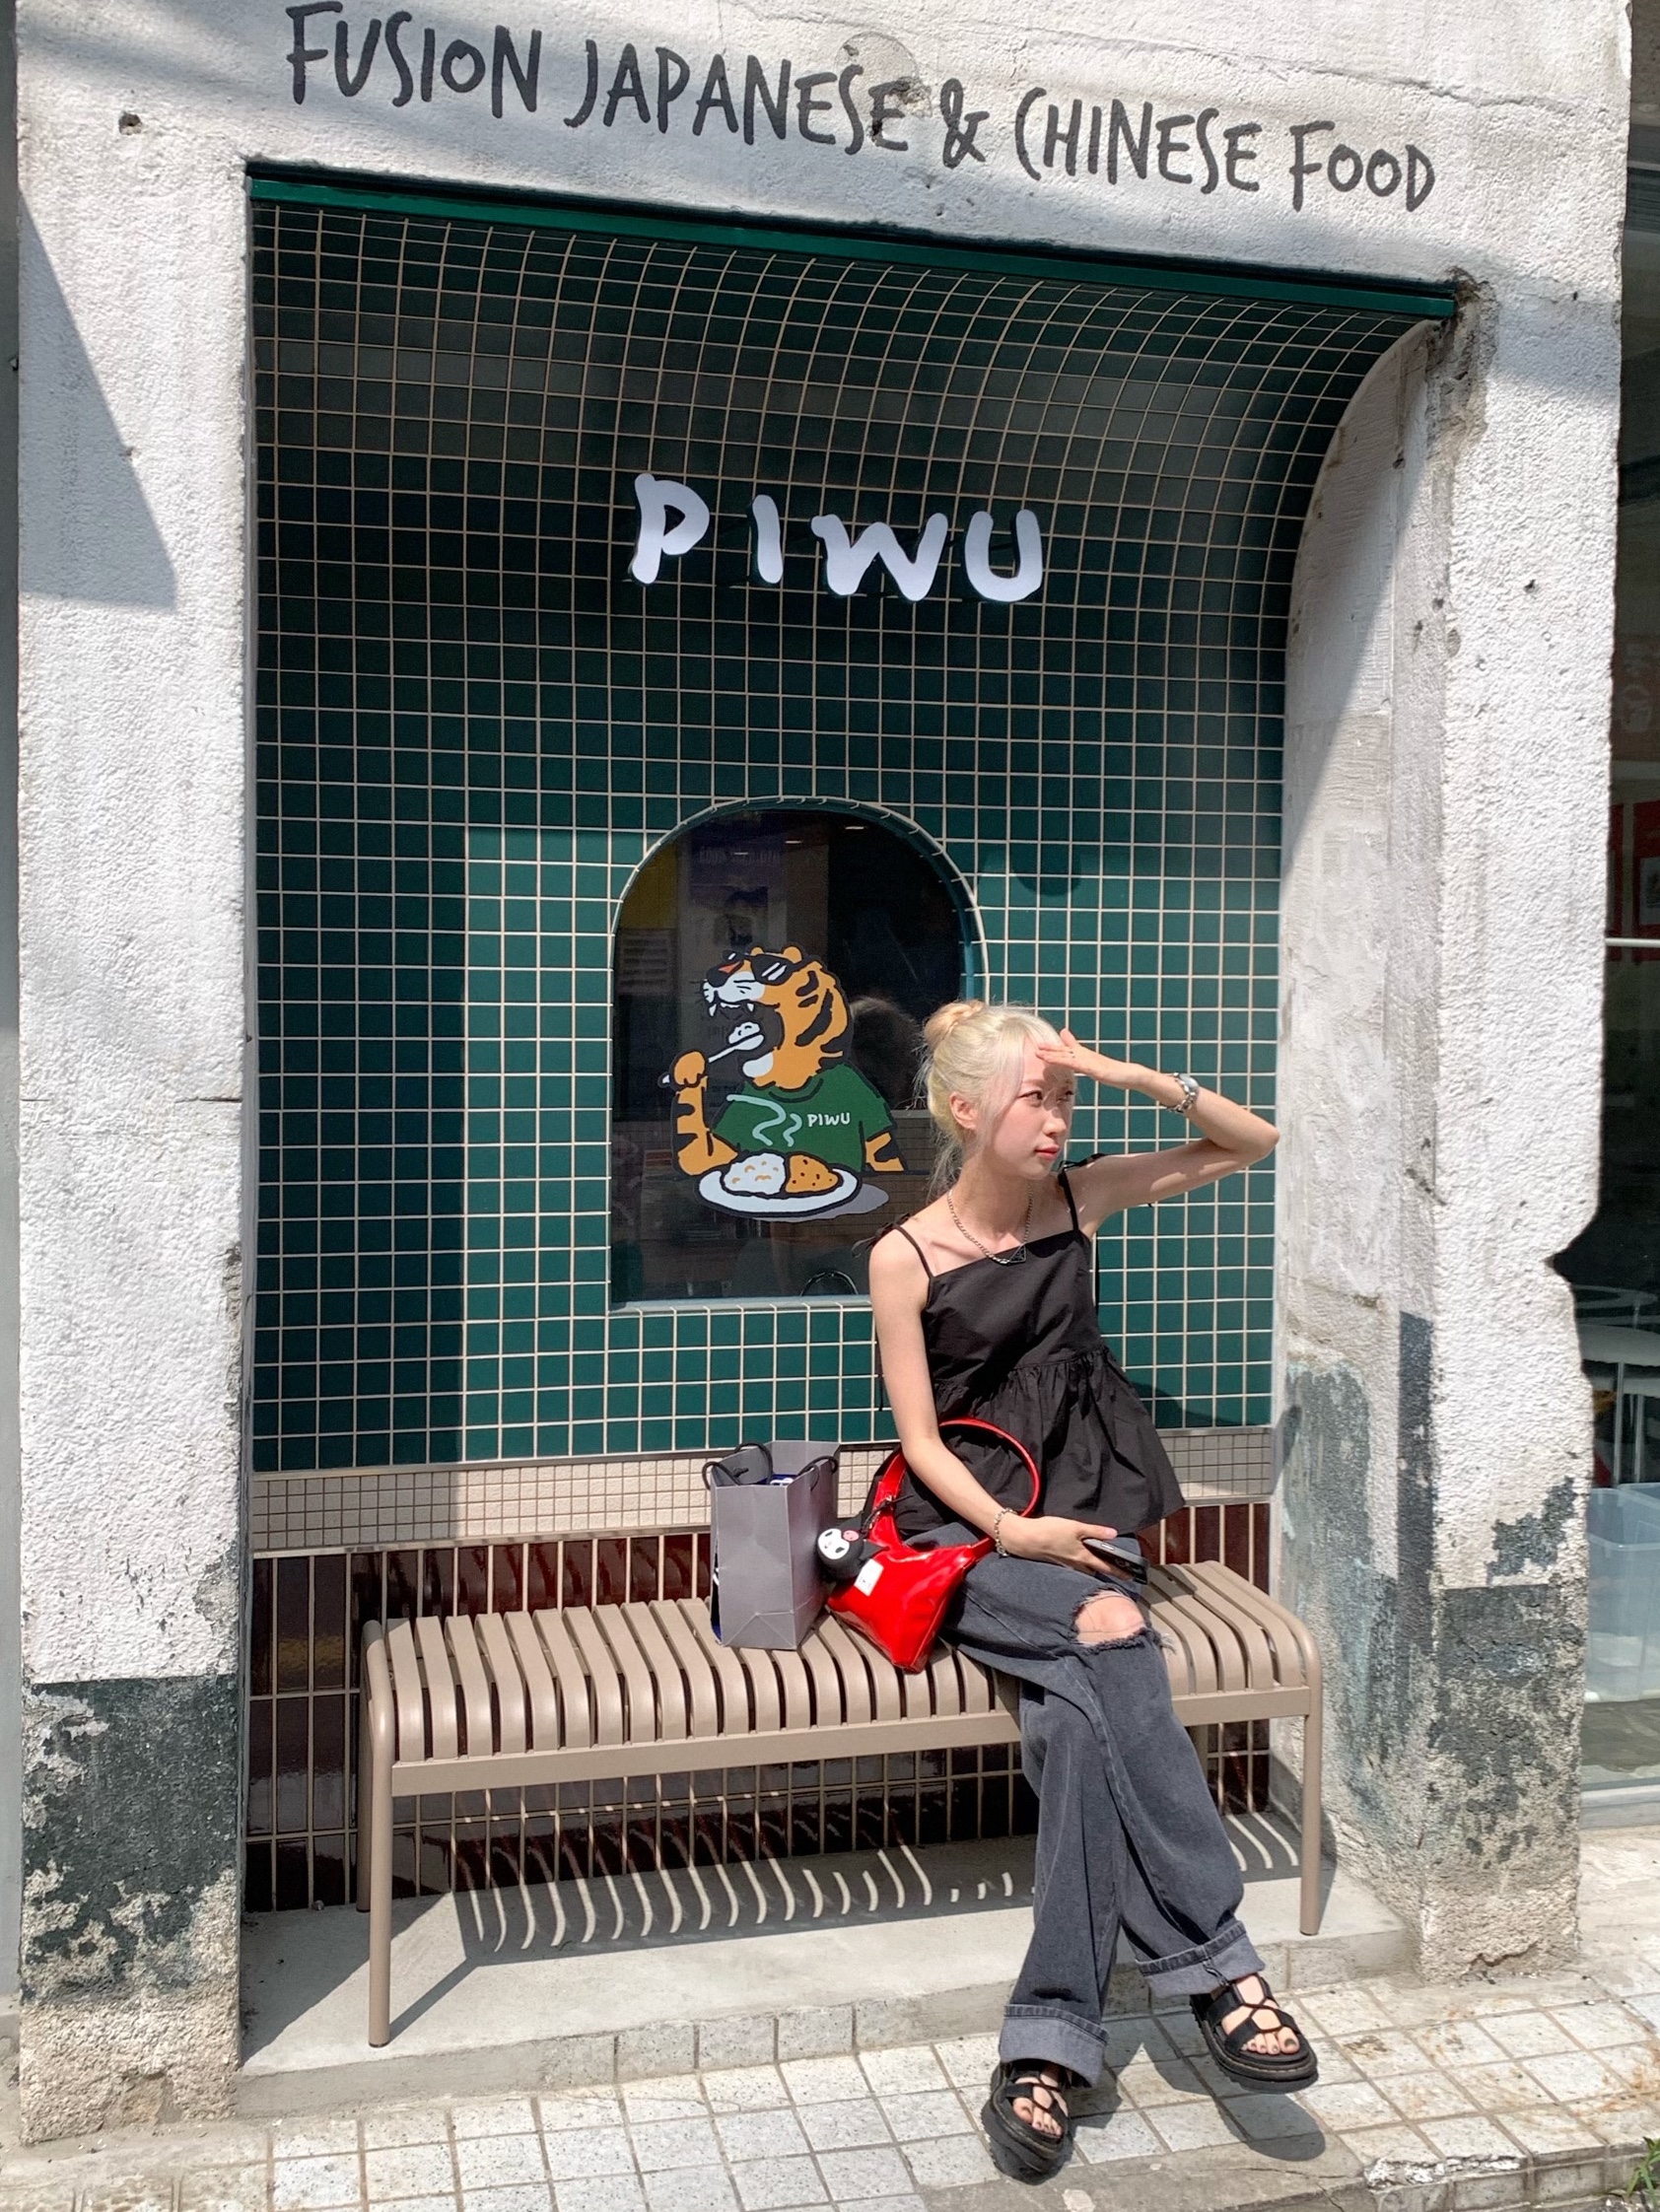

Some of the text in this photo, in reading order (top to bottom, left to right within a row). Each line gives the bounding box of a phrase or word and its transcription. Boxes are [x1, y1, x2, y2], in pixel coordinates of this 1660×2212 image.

[286, 1, 1436, 211] FUSION JAPANESE & CHINESE FOOD
[630, 472, 1044, 603] PIWU
[806, 1111, 851, 1128] PIWU
